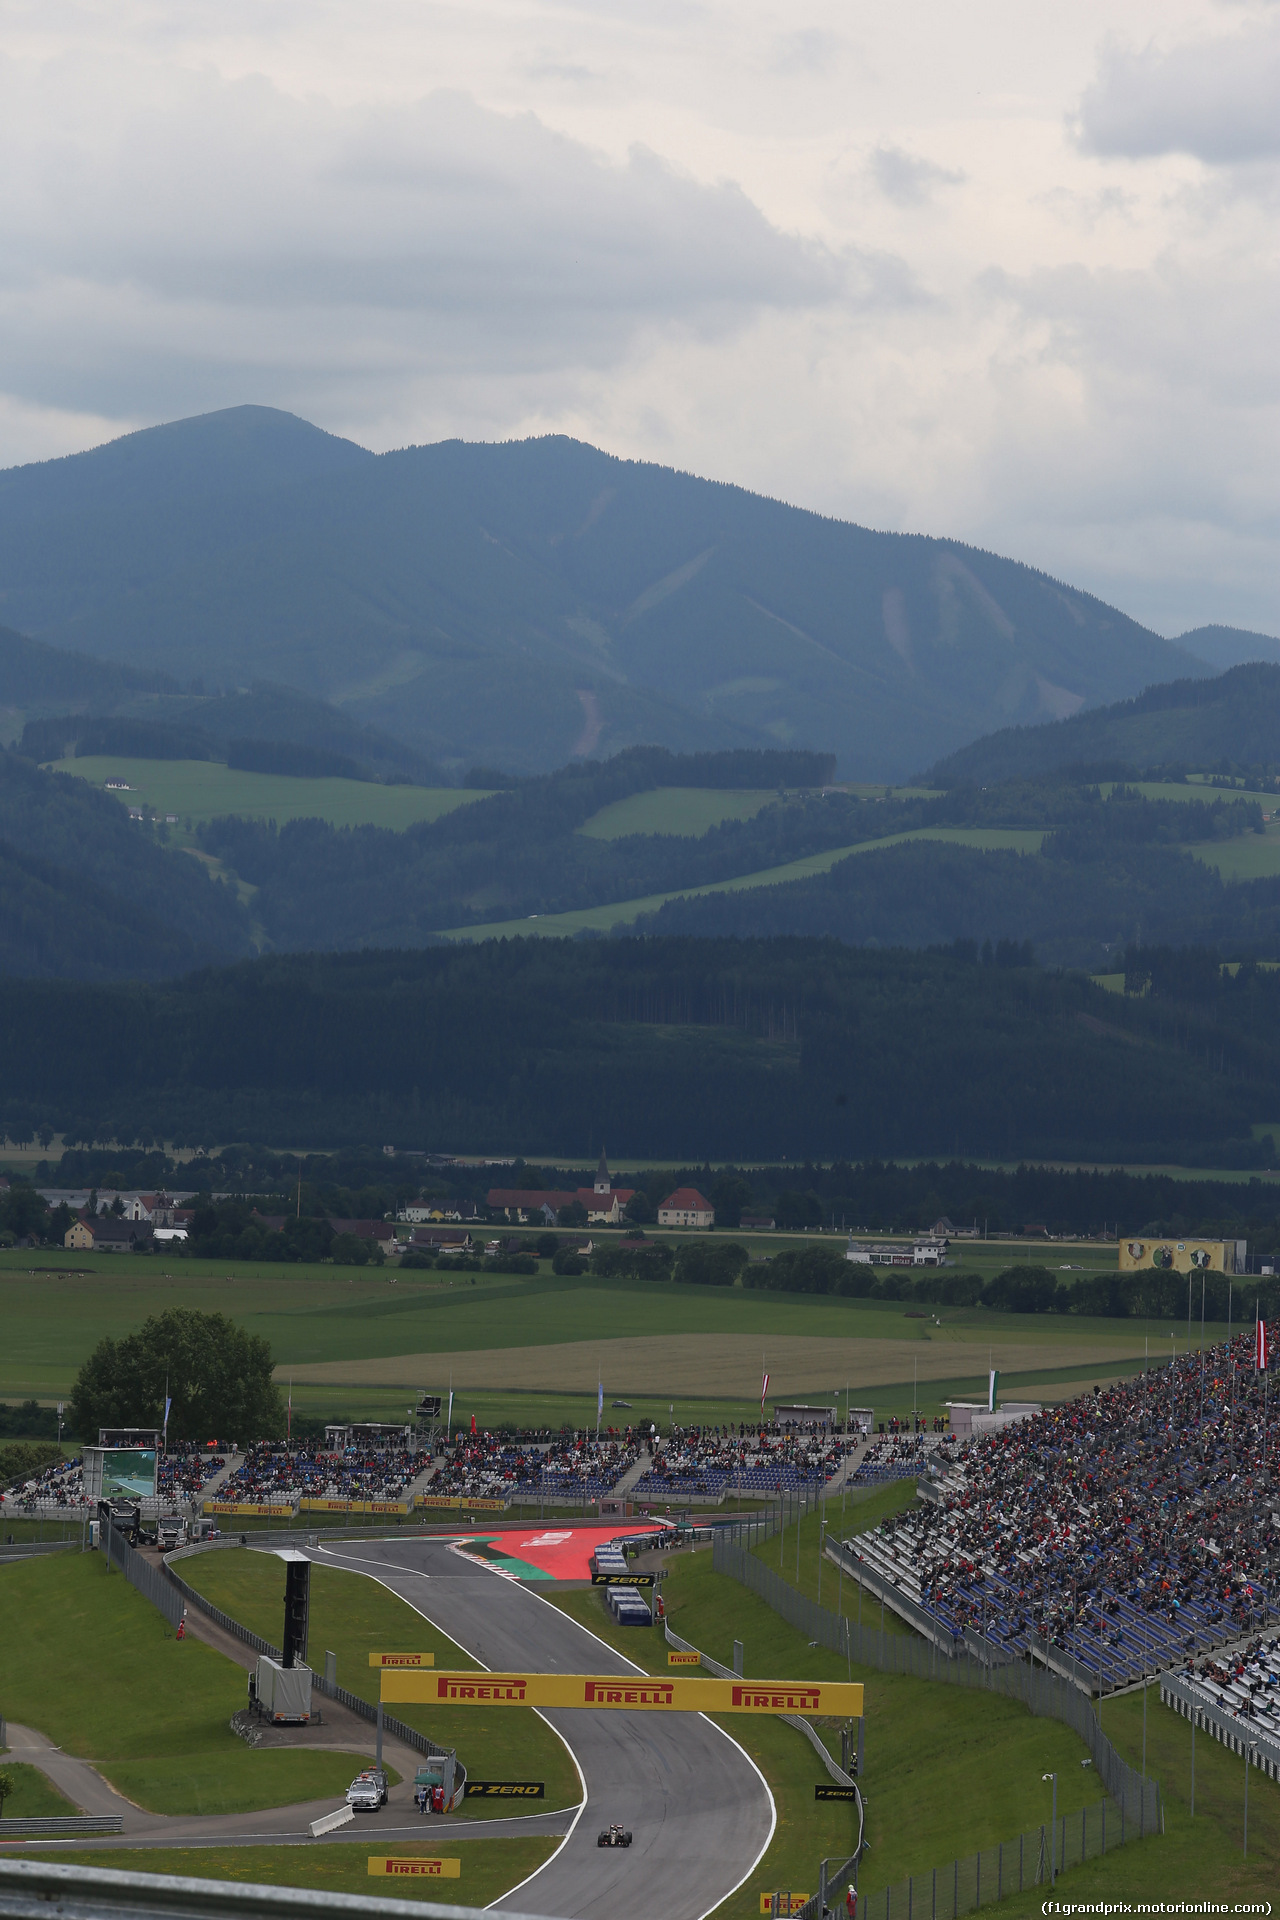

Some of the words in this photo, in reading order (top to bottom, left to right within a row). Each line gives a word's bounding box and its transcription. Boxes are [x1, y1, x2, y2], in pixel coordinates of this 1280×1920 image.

[424, 1497, 451, 1506] PIRELLI
[382, 1655, 422, 1665] PIRELLI
[671, 1655, 698, 1663] PIRELLI
[438, 1677, 527, 1700] PIRELLI
[585, 1681, 674, 1704] PIRELLI
[732, 1686, 821, 1709] PIRELLI
[468, 1785, 483, 1794] P
[486, 1786, 540, 1794] ZERO
[386, 1860, 442, 1874] PIRELLI
[764, 1898, 805, 1909] PRELL
